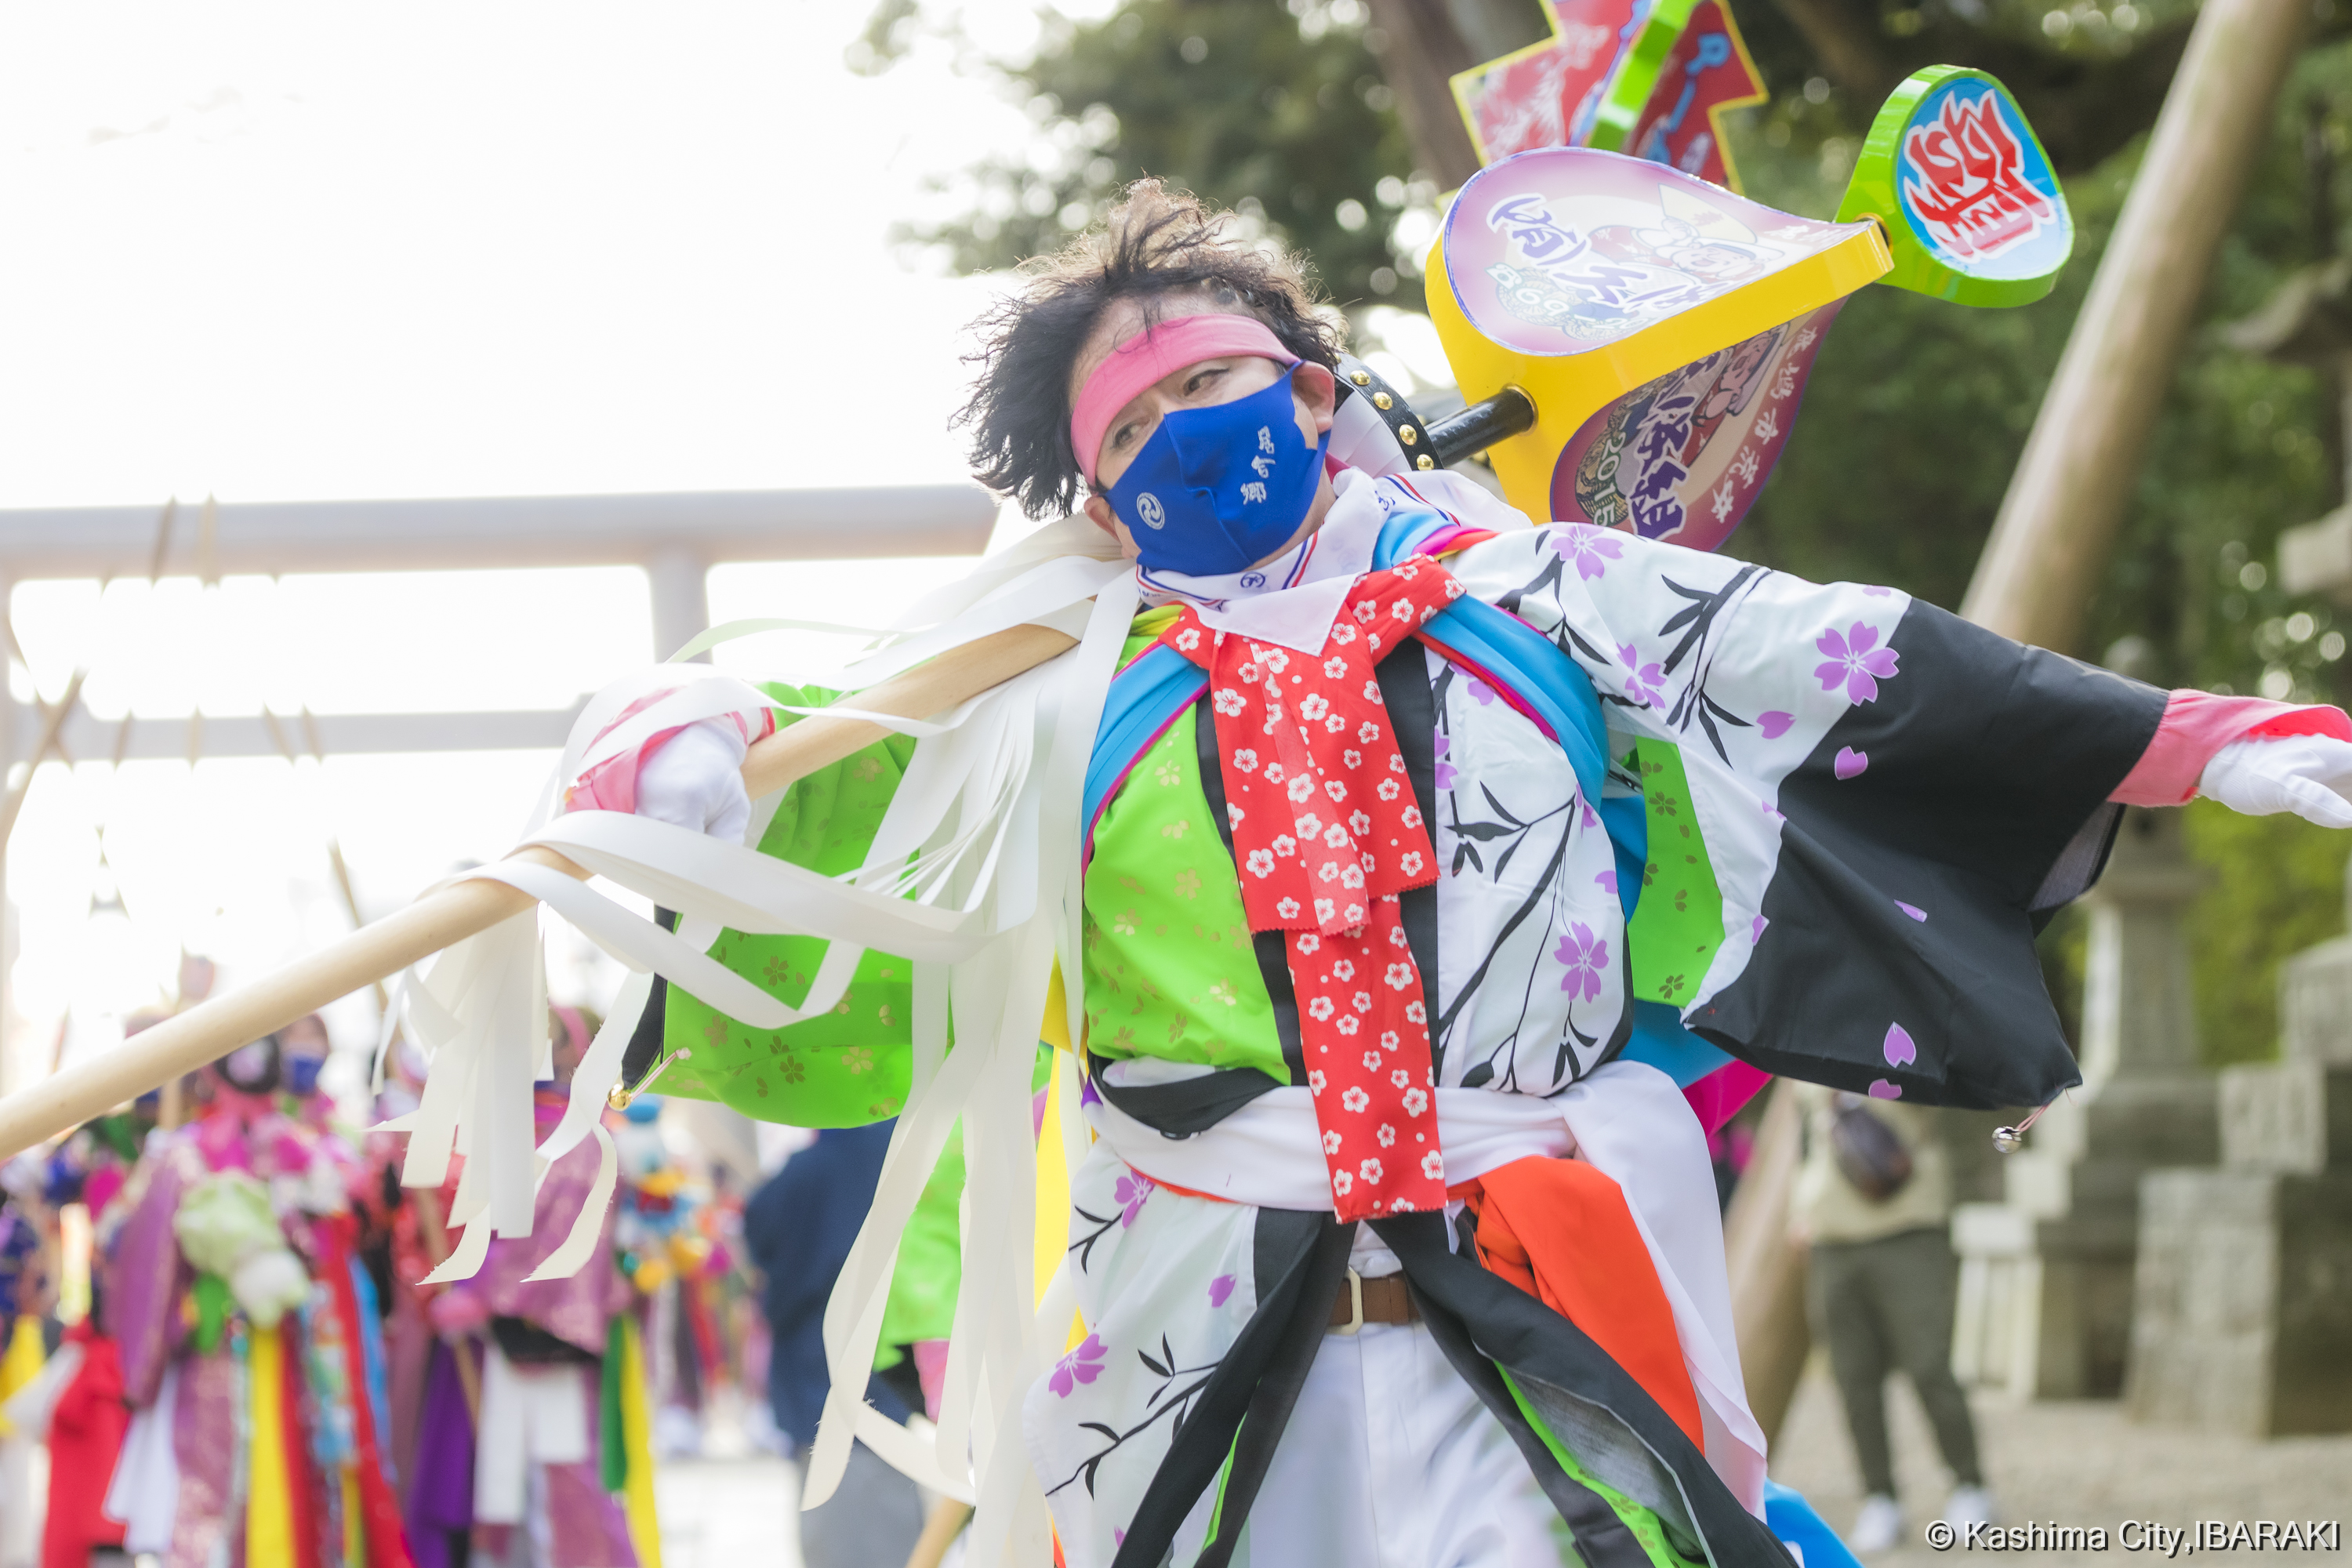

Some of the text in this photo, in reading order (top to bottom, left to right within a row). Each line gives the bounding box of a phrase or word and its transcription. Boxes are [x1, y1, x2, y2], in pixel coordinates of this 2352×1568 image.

[1712, 326, 1818, 524] 鹿嶋市荒井
